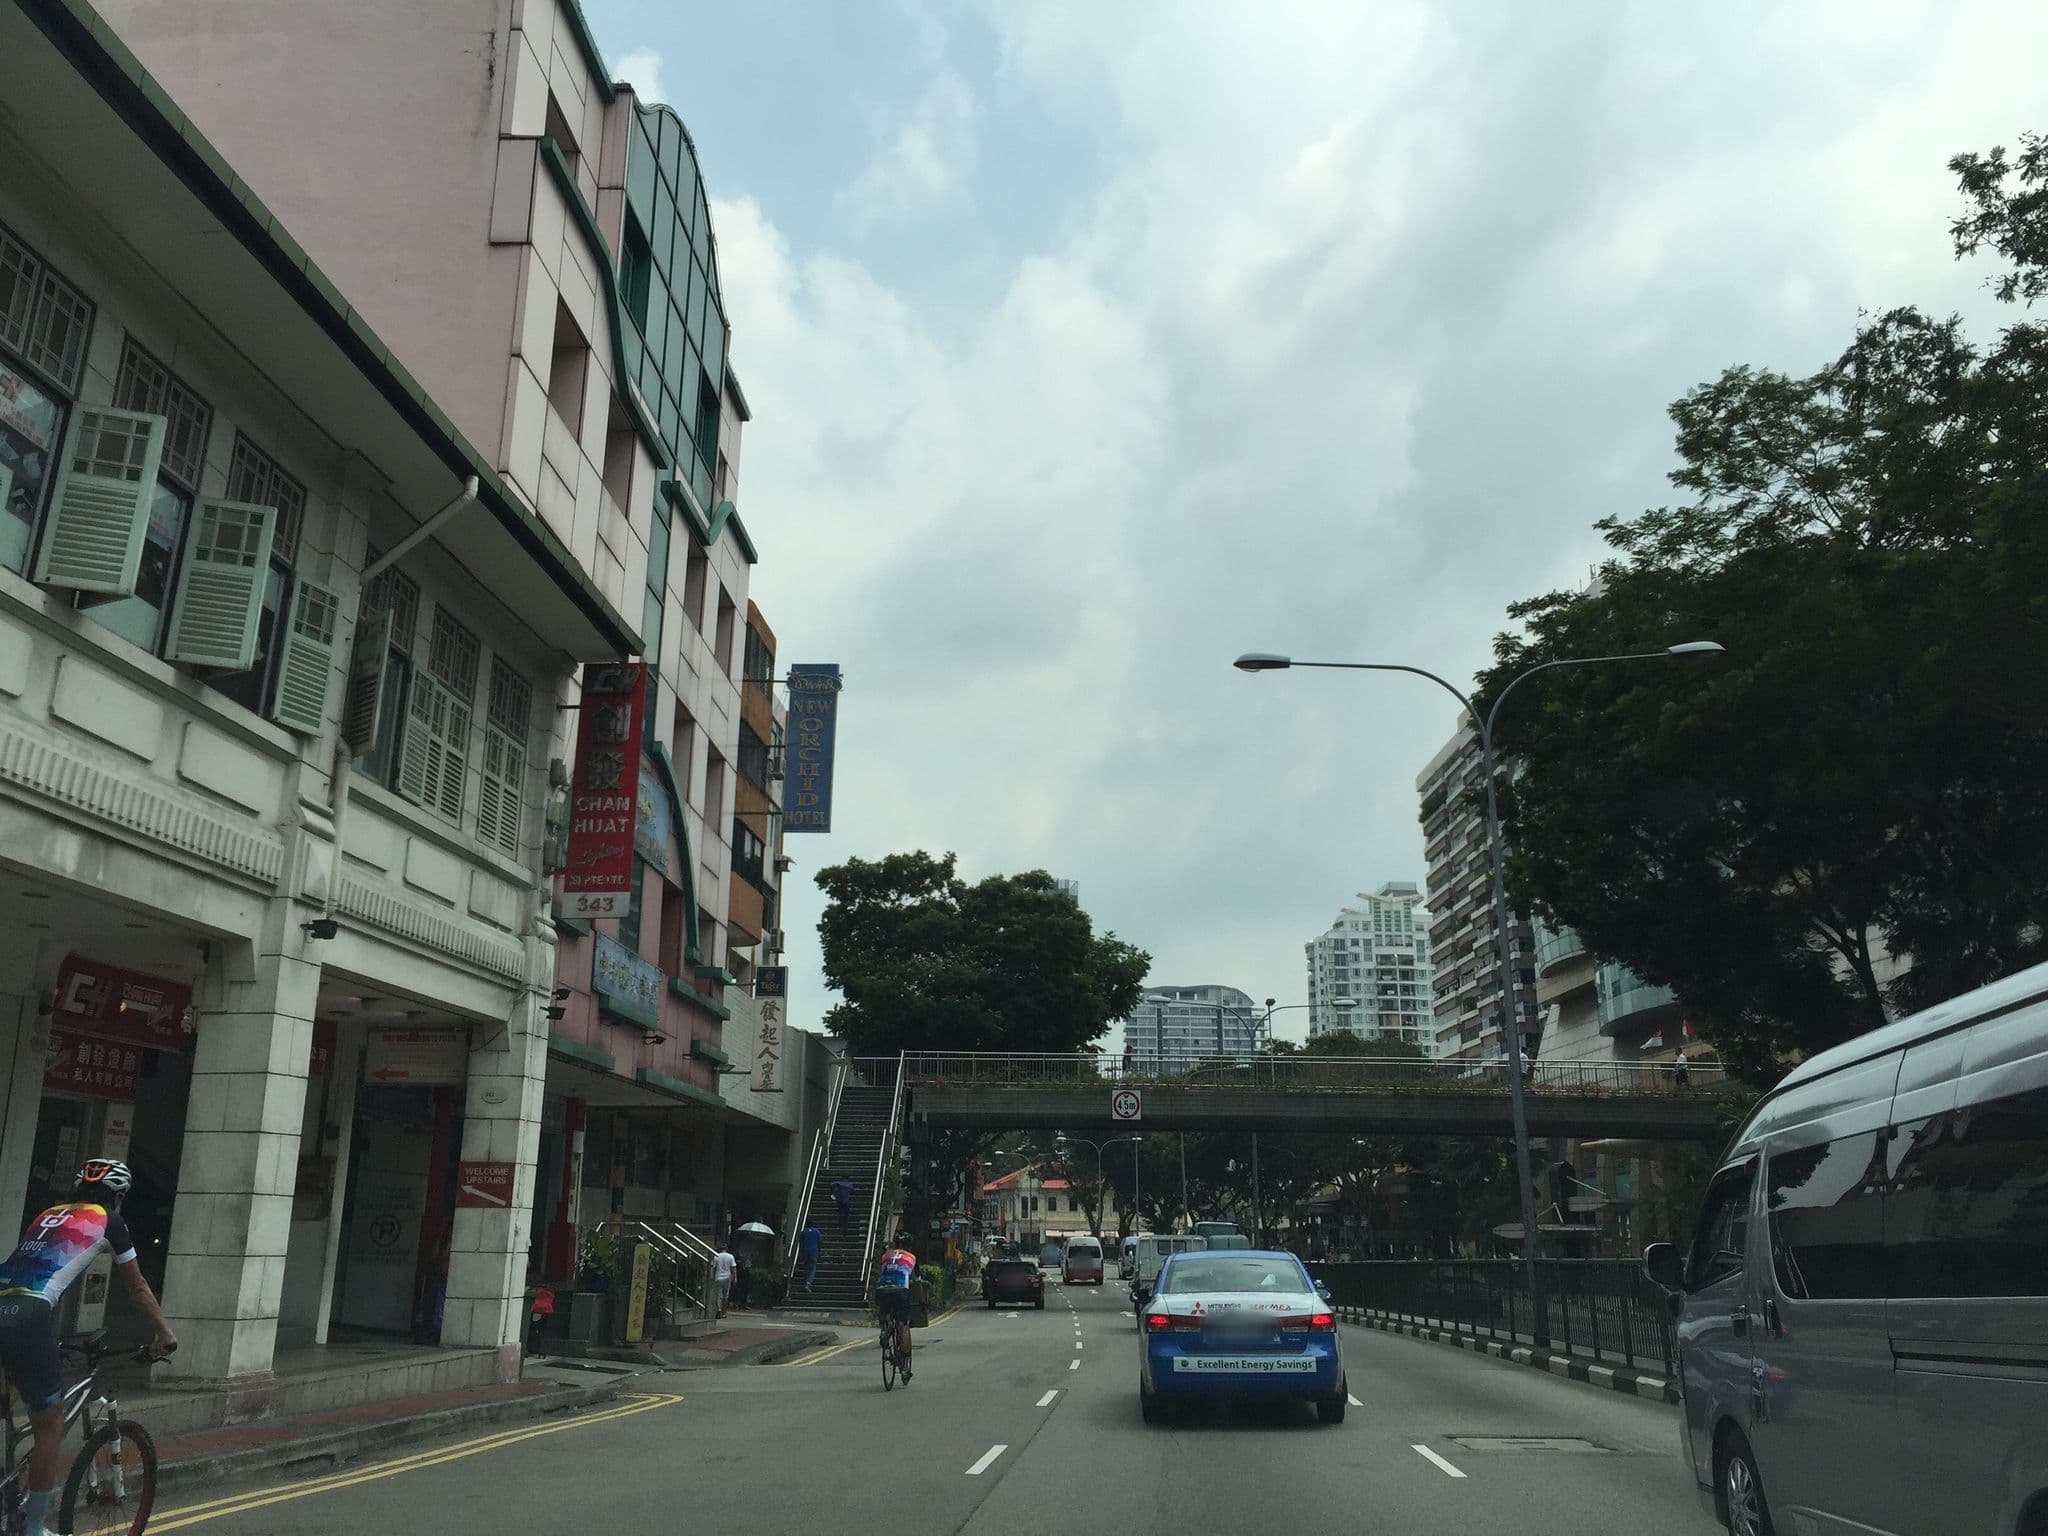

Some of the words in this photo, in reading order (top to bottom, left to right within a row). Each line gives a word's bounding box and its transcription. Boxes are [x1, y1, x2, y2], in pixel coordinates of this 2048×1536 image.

[794, 701, 832, 713] NEW
[798, 718, 824, 807] ORCHID
[576, 797, 630, 812] CHAN
[784, 811, 826, 825] HOTEL
[574, 818, 630, 834] HUAT
[584, 875, 603, 885] PTE
[605, 875, 626, 885] LTD
[577, 897, 614, 912] 343
[760, 981, 780, 992] Tiger
[465, 1167, 509, 1176] WELCOME
[466, 1176, 507, 1185] UPSTAIRS
[1197, 1359, 1240, 1369] Excellent
[1242, 1359, 1275, 1371] Energy
[1276, 1359, 1312, 1371] Savings
